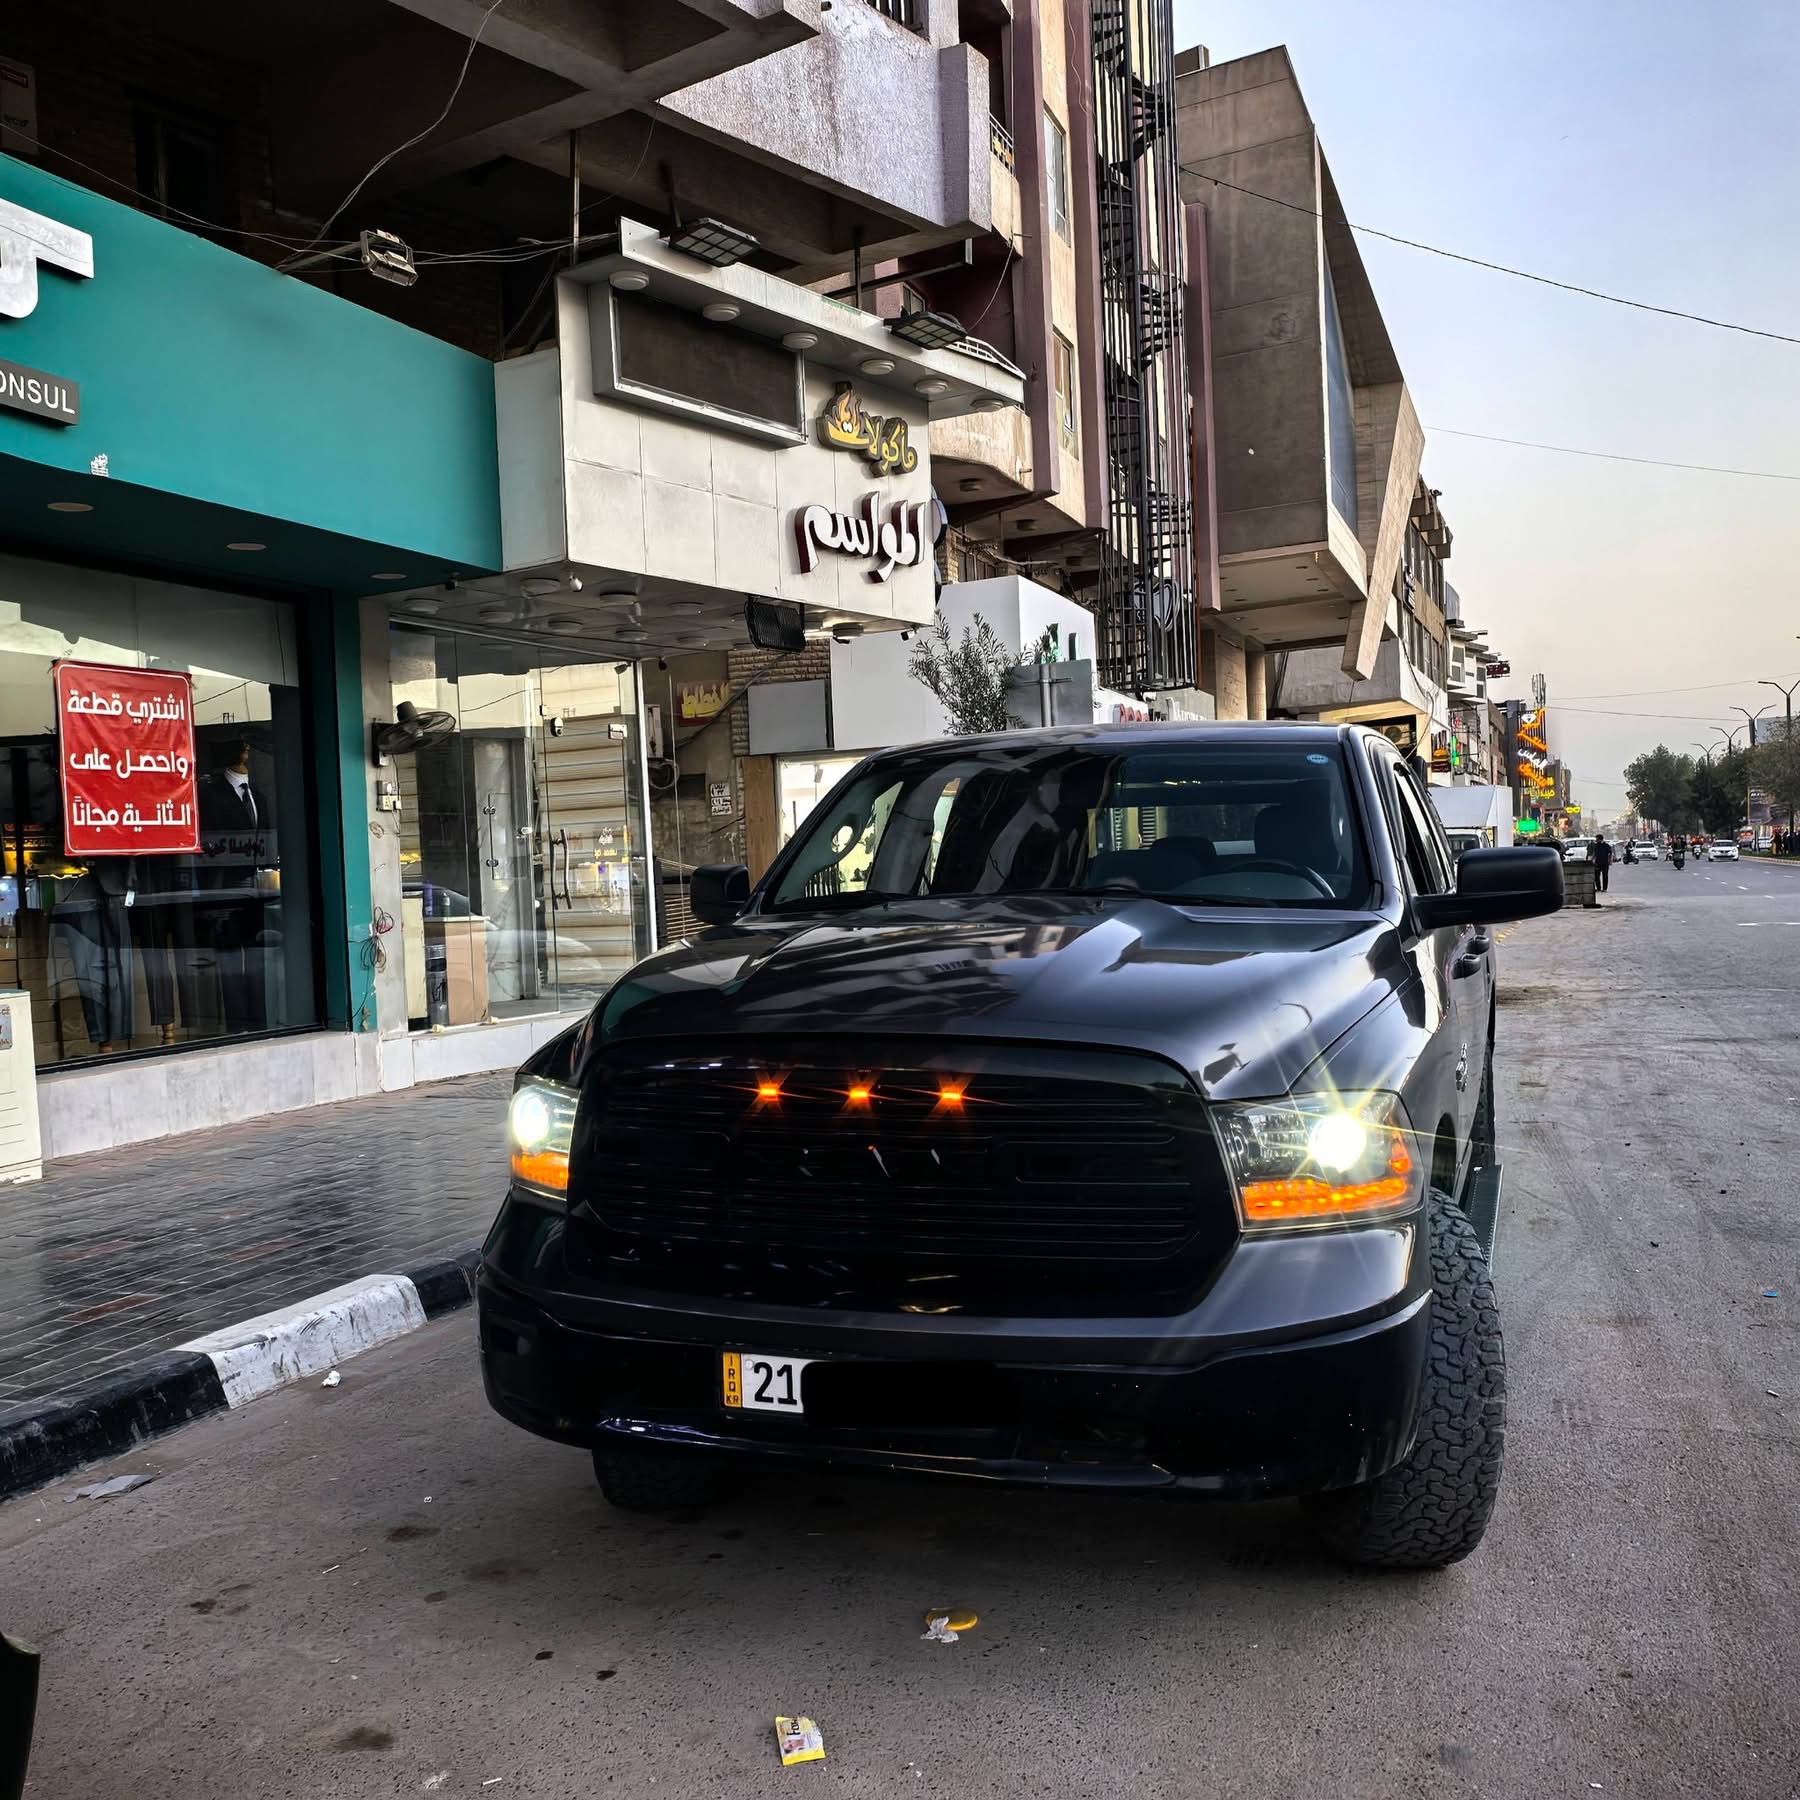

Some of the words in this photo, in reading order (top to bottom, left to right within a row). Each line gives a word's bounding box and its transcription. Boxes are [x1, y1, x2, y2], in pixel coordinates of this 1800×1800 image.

[797, 491, 926, 583] المواسم
[66, 689, 123, 716] قطعة
[126, 693, 185, 724] اشتري
[69, 747, 112, 771] على
[116, 748, 188, 779] واحصل
[122, 799, 192, 832] الثانية
[753, 1361, 798, 1406] 21
